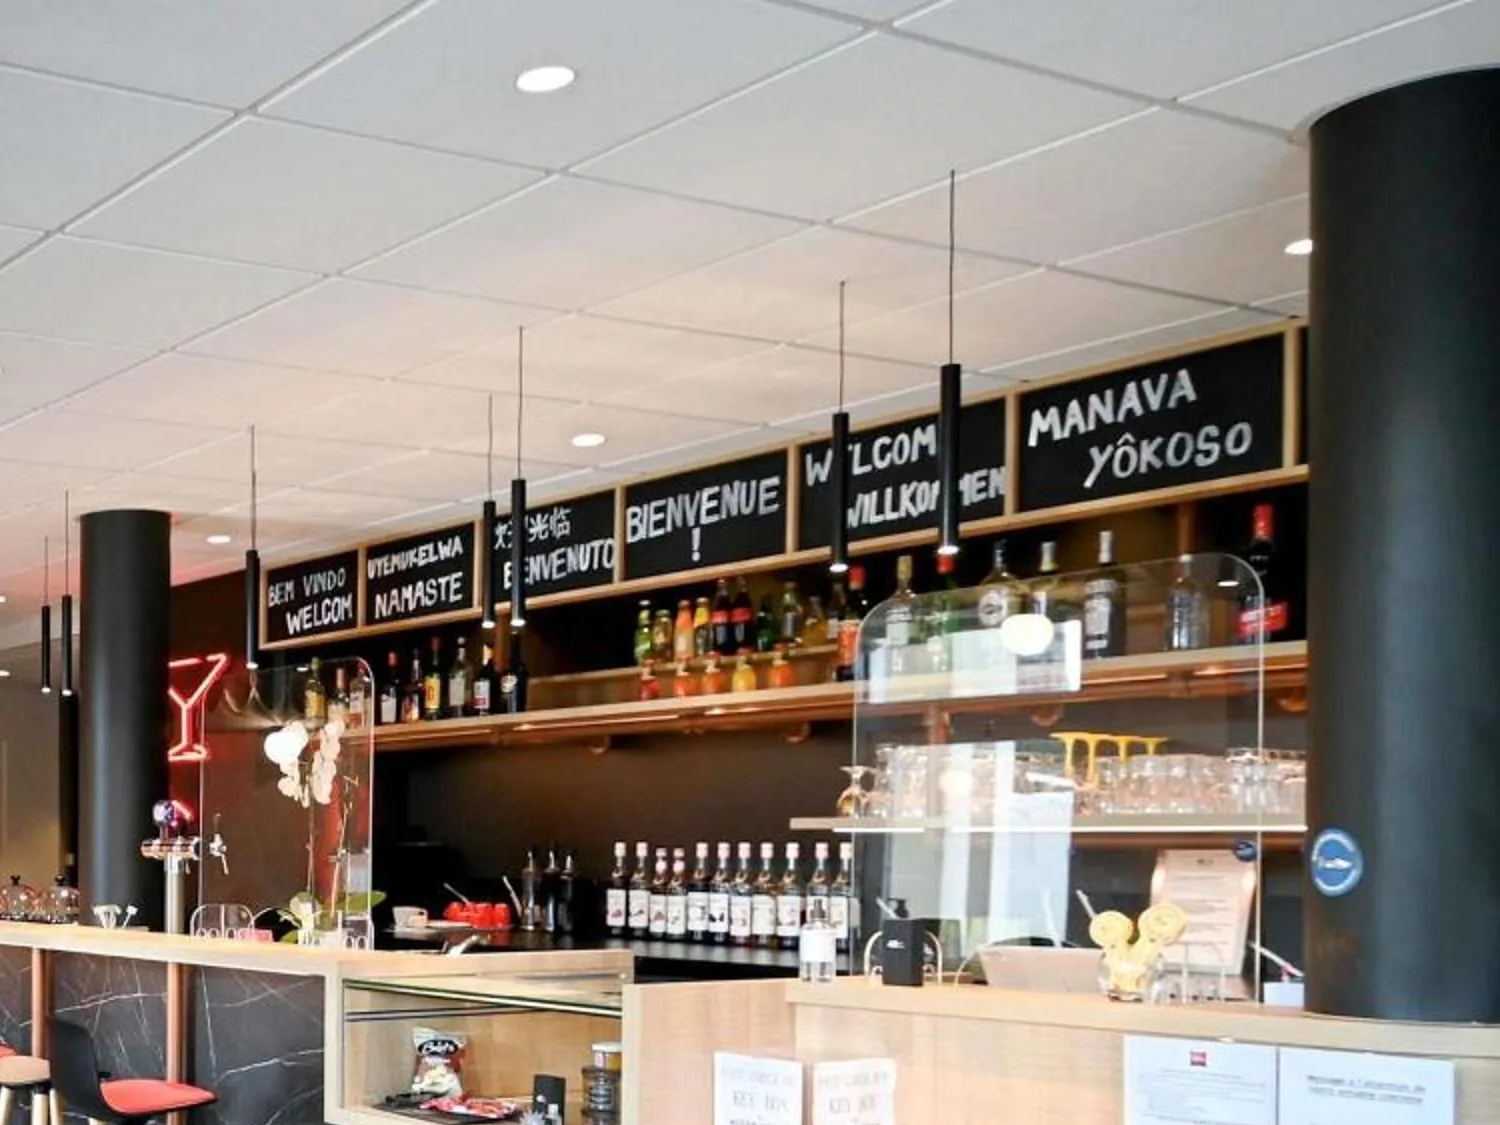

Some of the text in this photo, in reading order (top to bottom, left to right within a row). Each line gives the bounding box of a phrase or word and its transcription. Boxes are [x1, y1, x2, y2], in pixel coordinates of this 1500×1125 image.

[1028, 368, 1197, 447] MANAVA
[1083, 421, 1253, 489] YÔKOSO
[626, 476, 781, 543] BIENVENUE
[268, 567, 347, 607] BEM VINDO
[285, 592, 353, 635] WELCOM
[374, 571, 463, 619] NAMASTE
